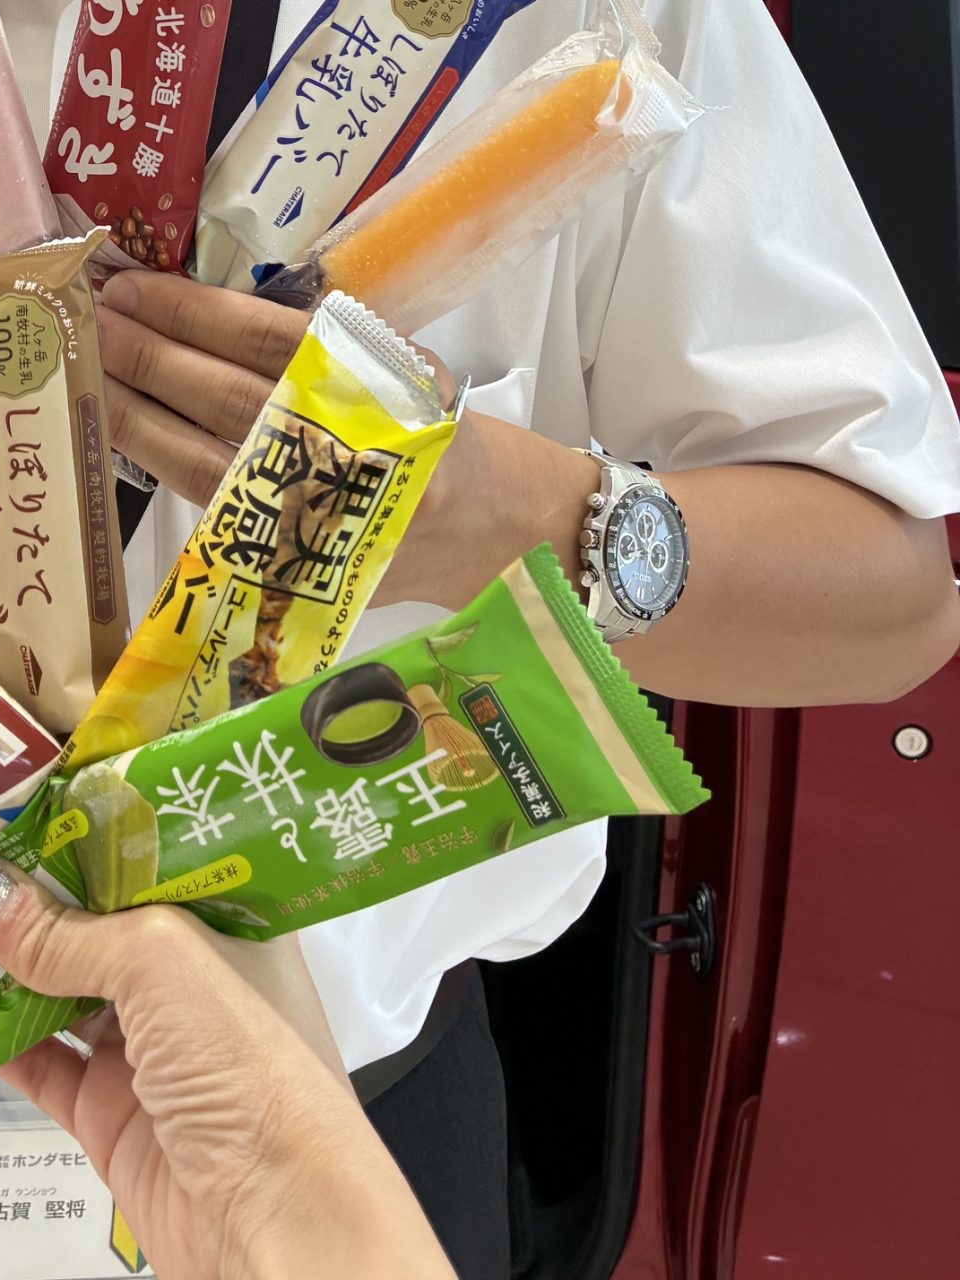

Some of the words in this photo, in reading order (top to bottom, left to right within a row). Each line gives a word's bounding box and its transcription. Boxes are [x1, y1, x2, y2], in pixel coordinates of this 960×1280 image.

[131, 7, 185, 179] 北海道十勝
[250, 15, 382, 195] 牛乳バー
[316, 33, 424, 178] しぼりたて
[13, 279, 78, 360] 新鮮ミルクのおいしさ
[16, 304, 33, 385] 南牧村の生乳
[32, 322, 47, 362] 八ヶ岳
[4, 406, 53, 608] しぼりたて
[313, 455, 415, 676] まるで果実そのもののような
[156, 729, 307, 845] 抹茶
[279, 748, 466, 862] 玉露と
[484, 722, 561, 821] 和菓子アイス
[15, 1187, 57, 1197] ケンショウ
[44, 1199, 86, 1219] 堅将
